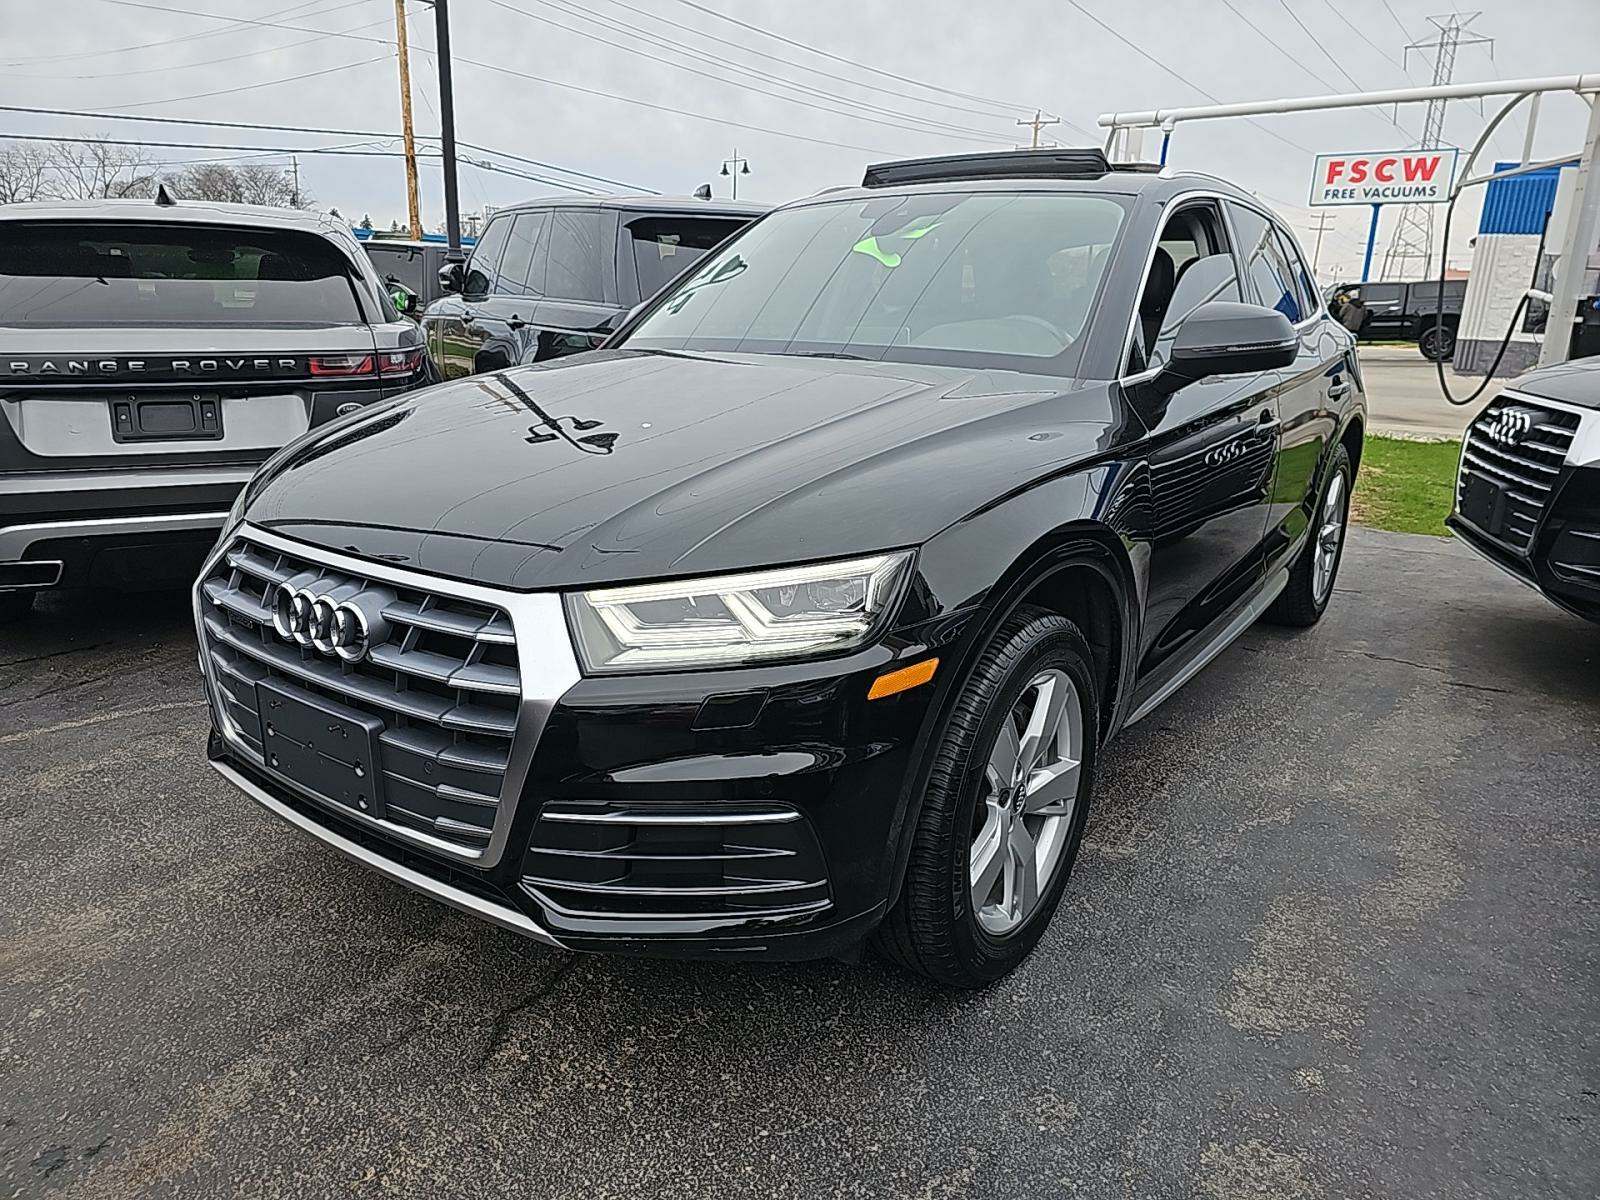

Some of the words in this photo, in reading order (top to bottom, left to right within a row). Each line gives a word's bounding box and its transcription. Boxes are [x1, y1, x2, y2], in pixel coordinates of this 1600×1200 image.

[1325, 156, 1441, 184] FSCW
[1324, 188, 1356, 200] FREE
[1363, 185, 1437, 199] VACUUMS
[9, 360, 147, 374] RANGE
[172, 358, 298, 373] ROVER
